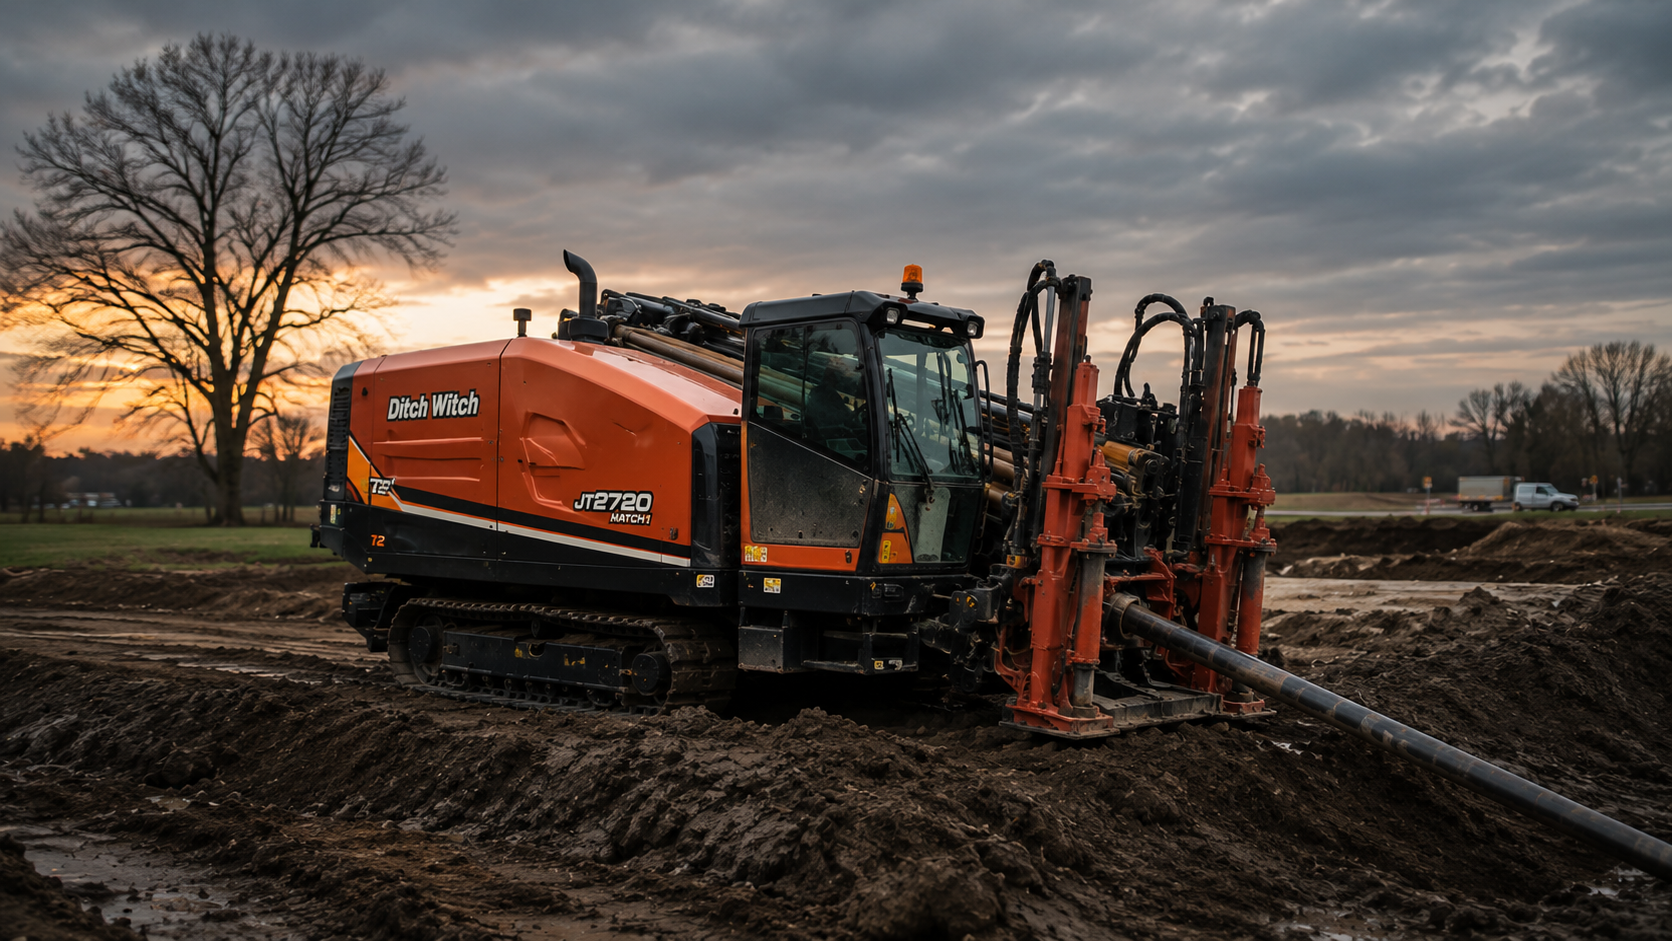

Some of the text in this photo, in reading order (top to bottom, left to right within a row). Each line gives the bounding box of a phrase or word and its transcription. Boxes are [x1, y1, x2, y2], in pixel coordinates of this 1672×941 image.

[387, 390, 479, 420] Ditch Witch
[574, 491, 653, 512] JT2720
[370, 534, 386, 547] 72
